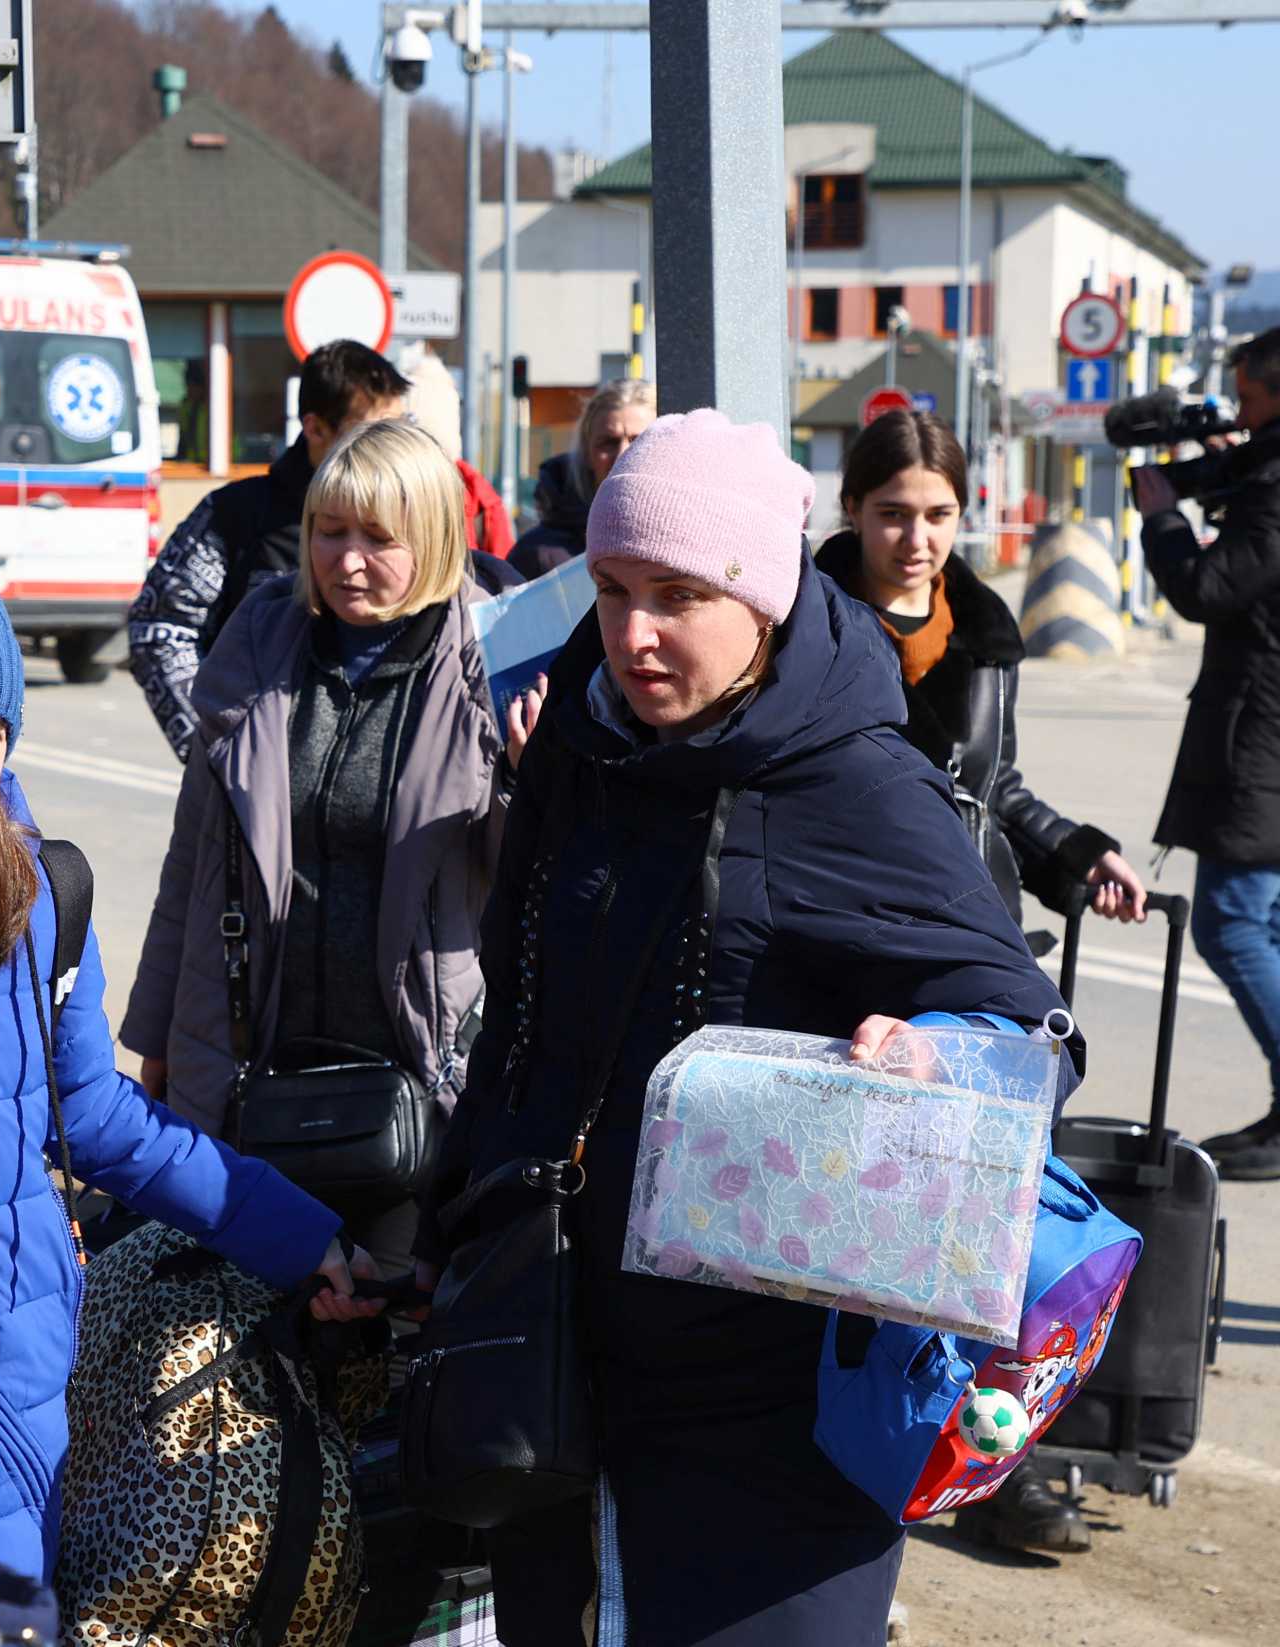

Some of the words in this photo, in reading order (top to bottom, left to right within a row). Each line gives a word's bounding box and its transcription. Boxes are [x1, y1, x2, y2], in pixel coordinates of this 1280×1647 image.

[1082, 307, 1103, 341] 5
[775, 1070, 853, 1103] Beautiful
[864, 1086, 918, 1106] leaves
